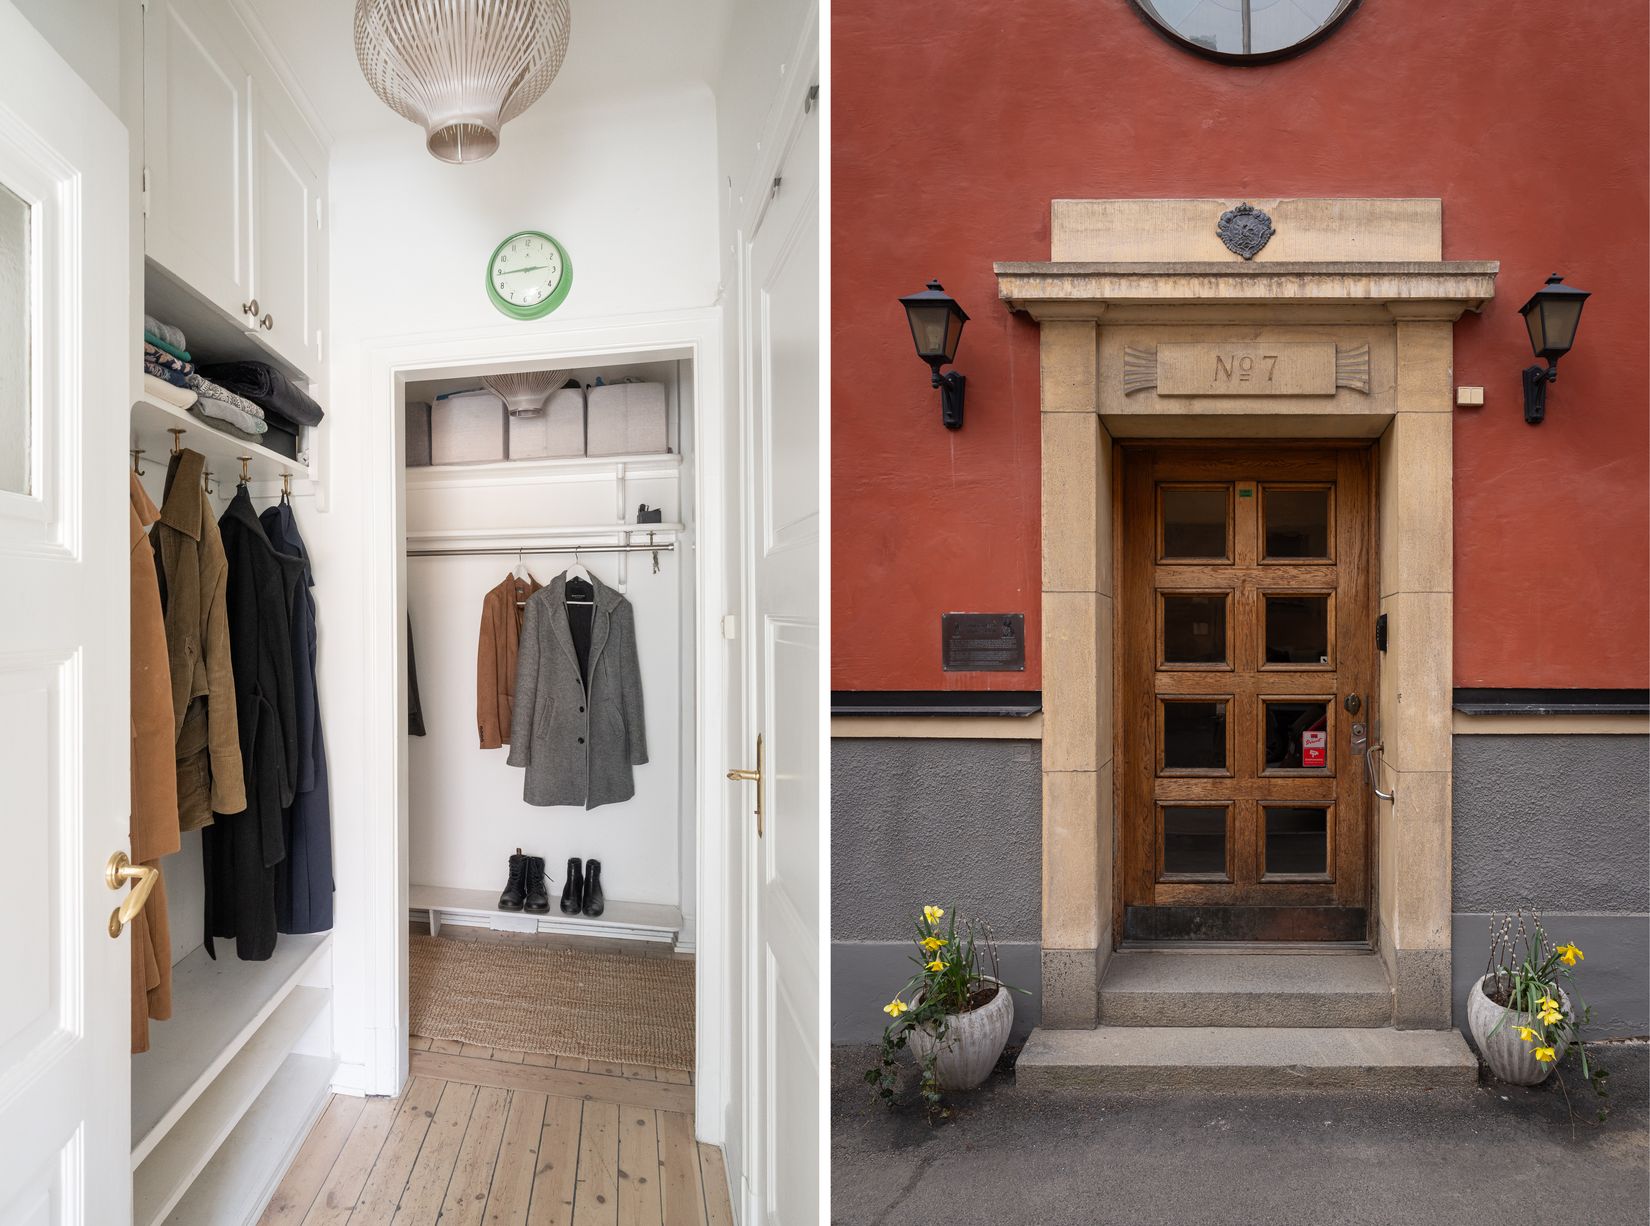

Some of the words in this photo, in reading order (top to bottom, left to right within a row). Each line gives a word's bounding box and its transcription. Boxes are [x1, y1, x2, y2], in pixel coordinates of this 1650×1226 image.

[525, 239, 531, 247] 12
[549, 252, 554, 260] 2
[551, 266, 556, 274] 3
[500, 281, 505, 289] 8
[510, 292, 514, 300] 7
[537, 291, 542, 299] 5
[1262, 354, 1279, 382] 7
